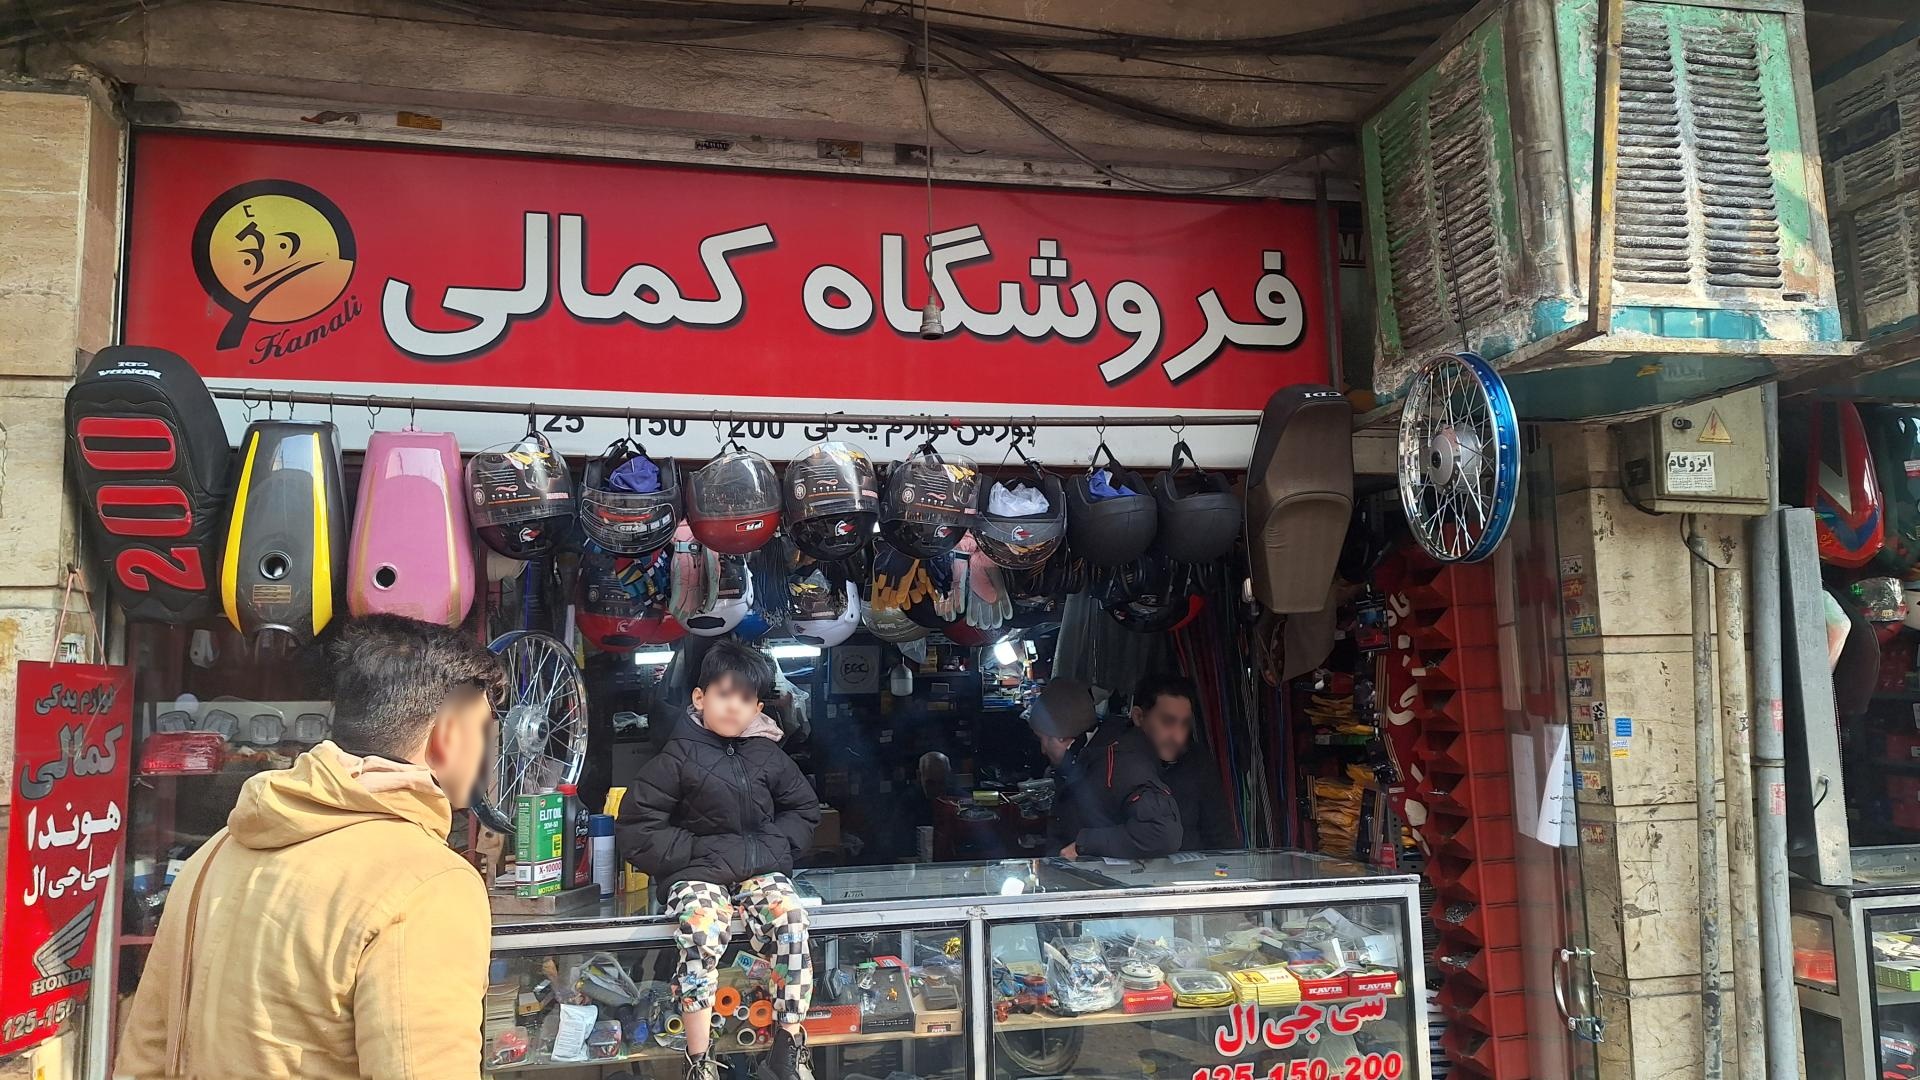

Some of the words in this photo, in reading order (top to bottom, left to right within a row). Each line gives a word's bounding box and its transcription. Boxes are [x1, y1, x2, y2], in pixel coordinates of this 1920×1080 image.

[381, 211, 777, 361] کمالی
[802, 222, 1305, 385] فروشگاه
[249, 295, 362, 365] Kamali
[634, 413, 687, 436] 150
[728, 416, 785, 439] 200
[1669, 455, 1711, 472] ایزوگام
[76, 416, 207, 592] 200
[35, 683, 79, 715] یدکی
[80, 683, 117, 715] لوازم
[21, 722, 124, 800] کمالی
[27, 801, 121, 851] هوندا
[23, 864, 47, 906] ال
[48, 866, 81, 899] جی
[31, 966, 92, 996] HONDA
[1308, 986, 1343, 995] KAVIR
[1358, 982, 1392, 991] KAVIR
[3, 998, 77, 1042] 125-150
[1215, 1000, 1258, 1056] ال
[1263, 1000, 1326, 1049] جی
[1327, 994, 1387, 1035] سی
